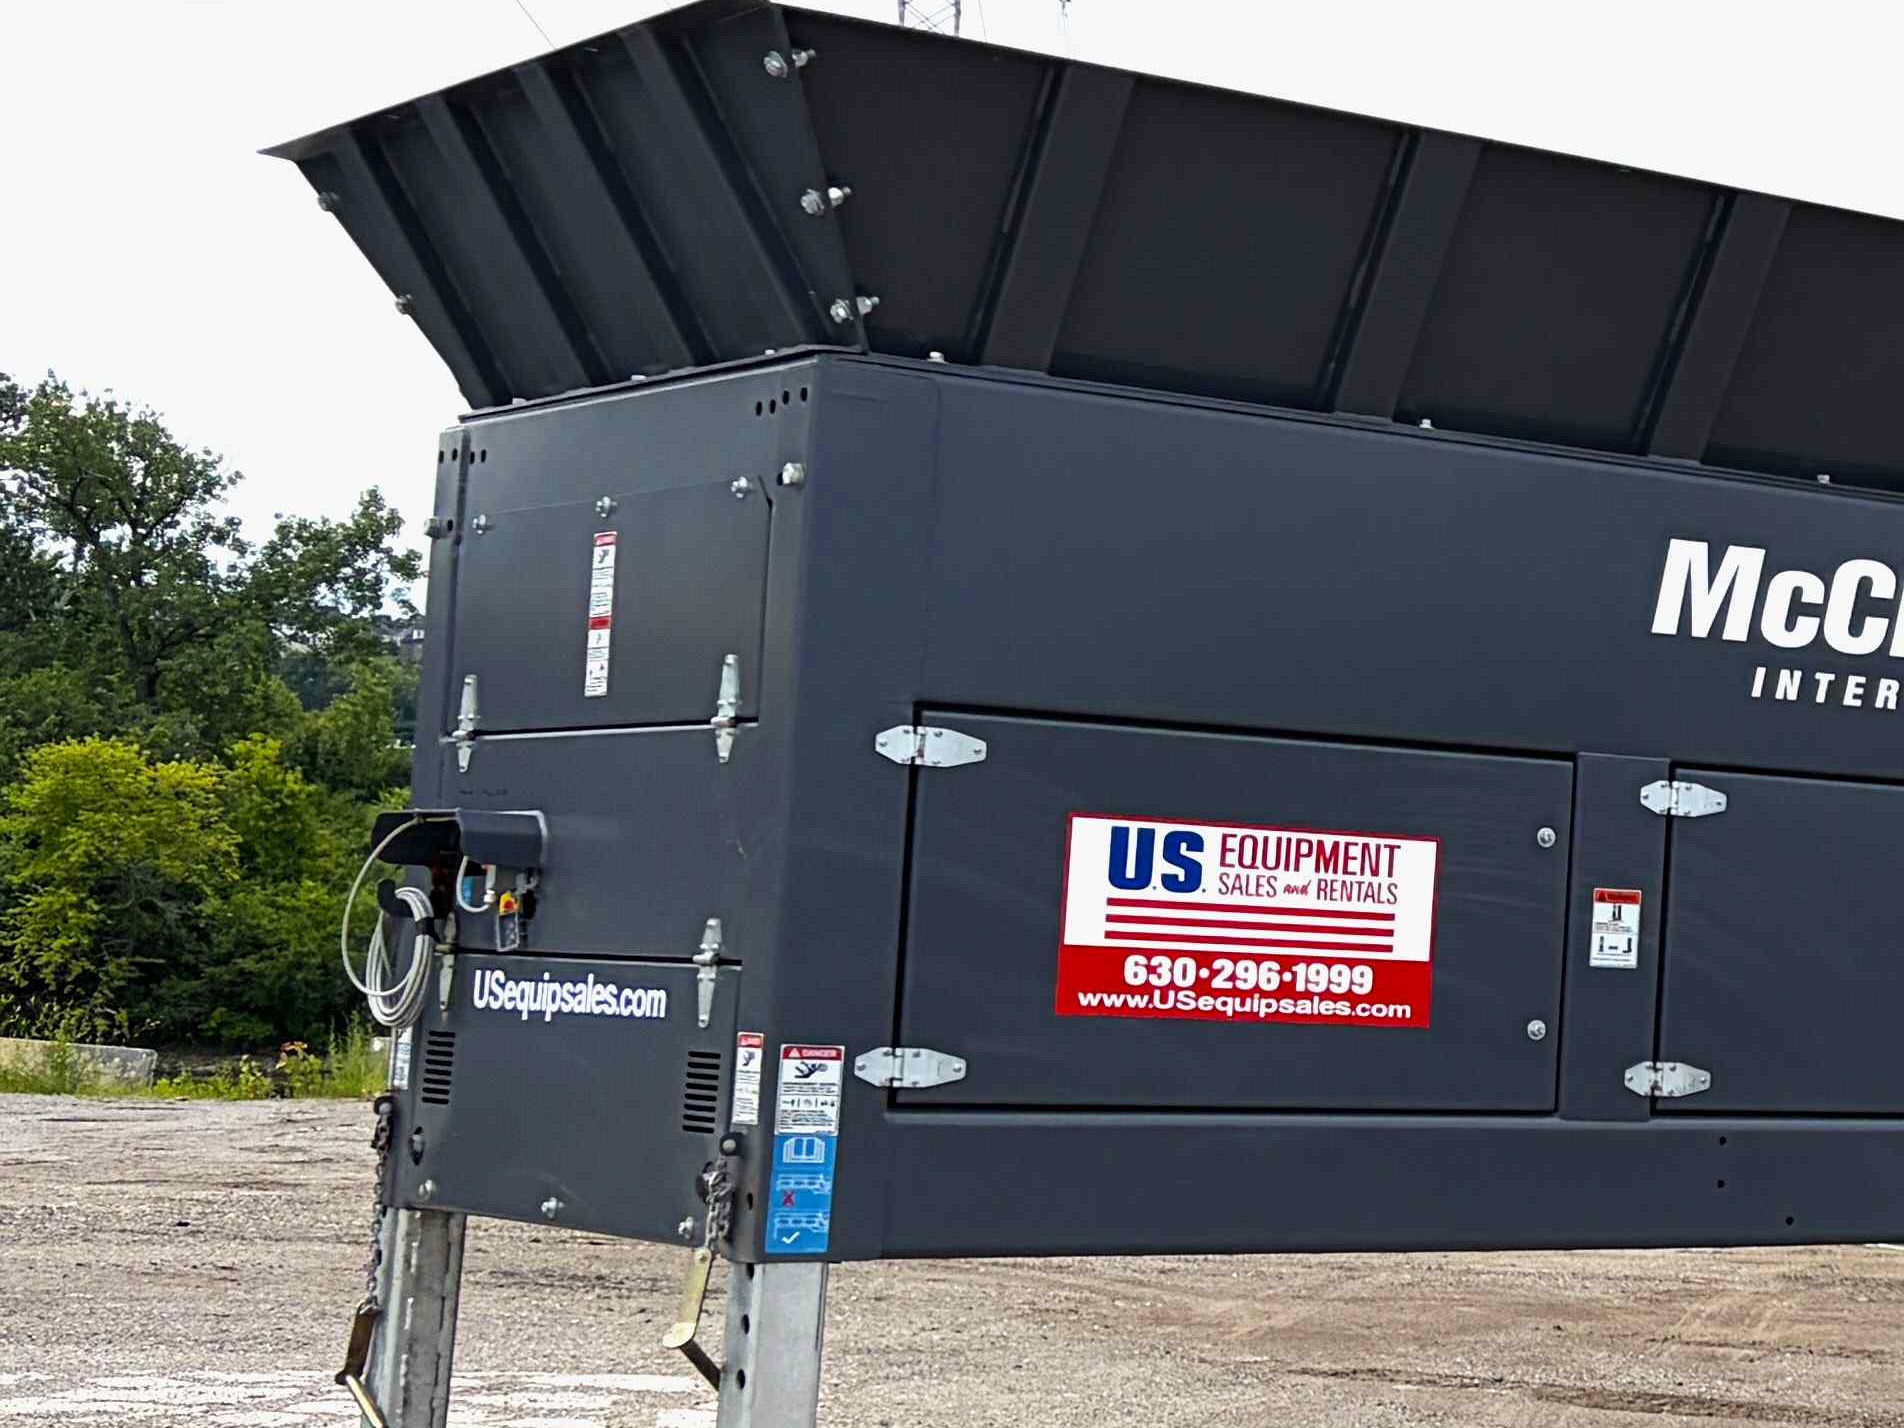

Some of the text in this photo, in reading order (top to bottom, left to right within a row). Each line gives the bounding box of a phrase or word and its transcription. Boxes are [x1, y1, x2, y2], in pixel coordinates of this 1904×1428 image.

[1219, 833, 1401, 878] EQUIPMENT
[1218, 872, 1398, 905] SALES and RENTALS
[473, 969, 667, 1022] USequipsales.com
[1077, 990, 1412, 1019] www.USequipsales.com
